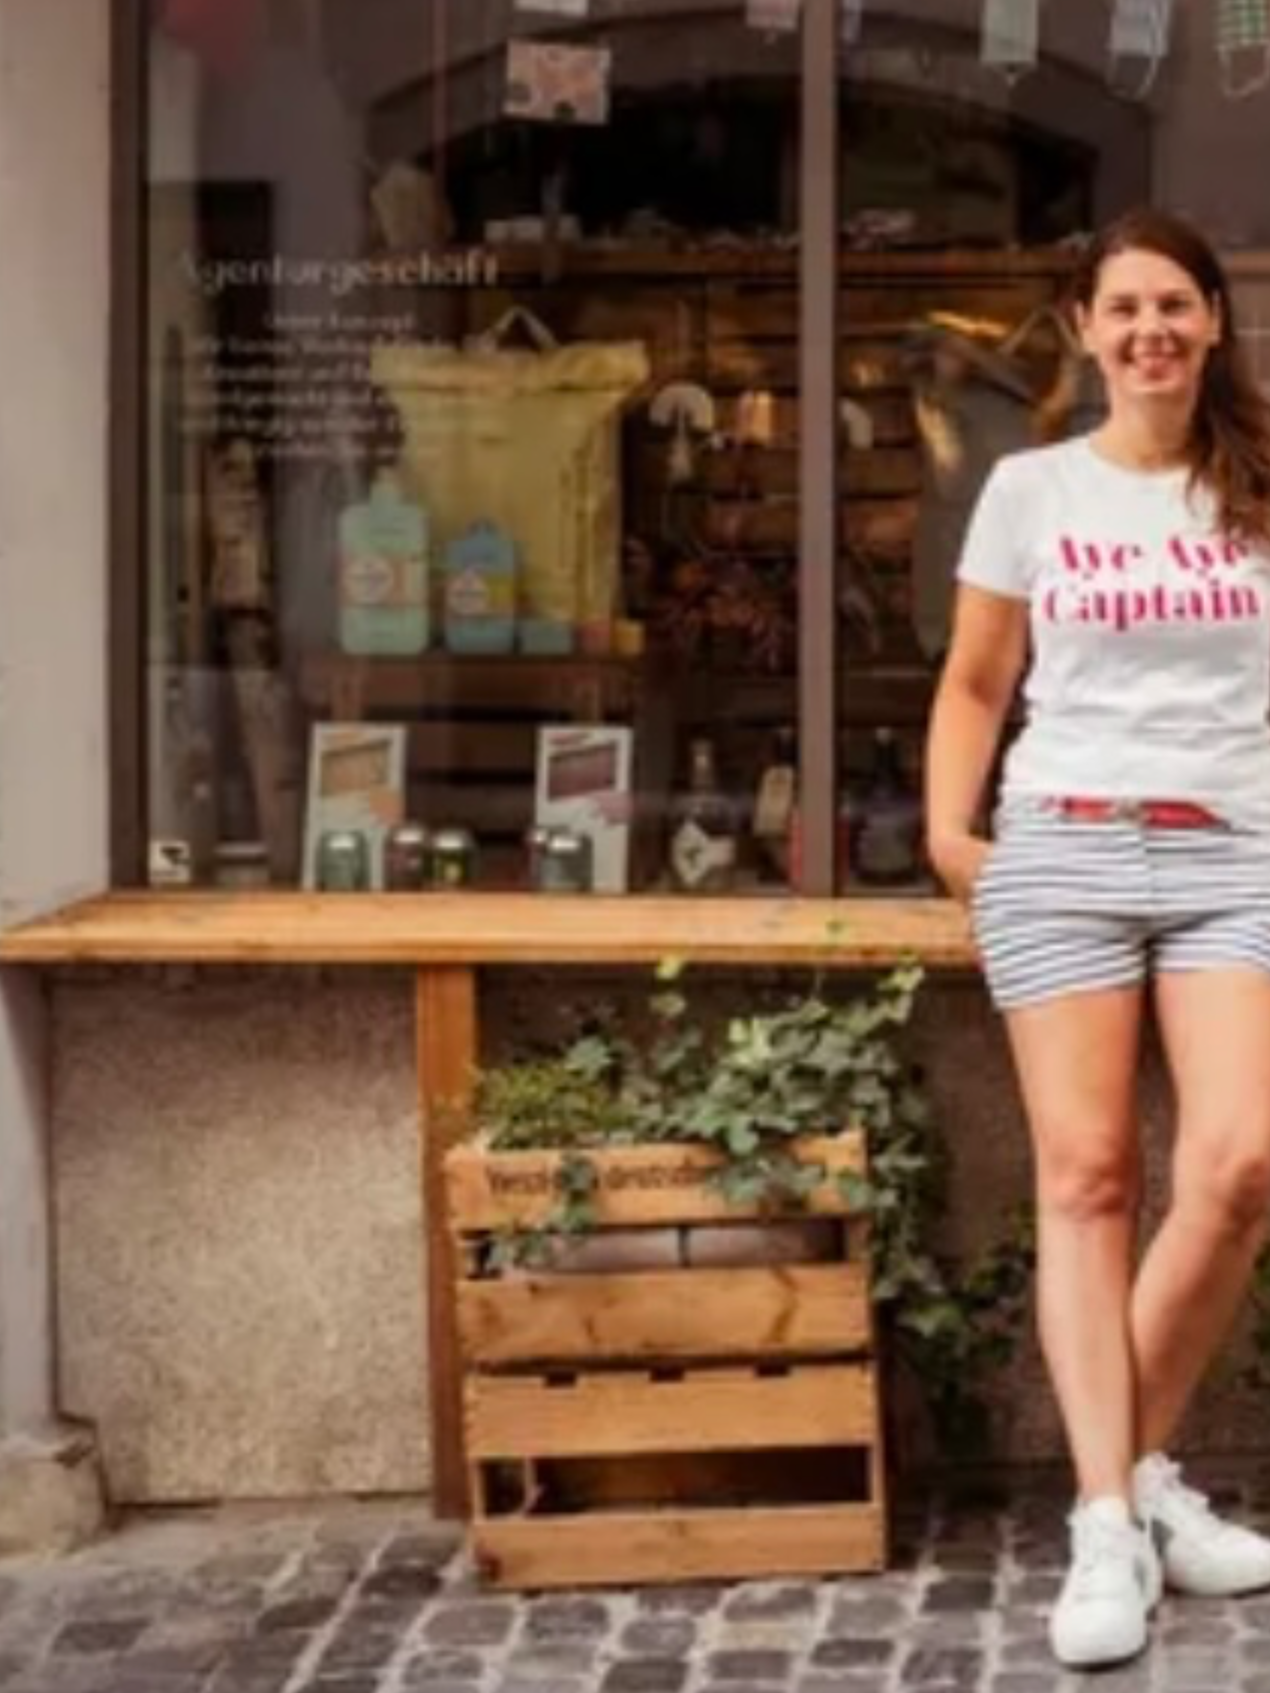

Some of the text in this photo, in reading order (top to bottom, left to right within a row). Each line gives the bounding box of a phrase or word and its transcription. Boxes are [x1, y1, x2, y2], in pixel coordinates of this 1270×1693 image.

[181, 248, 498, 294] Agenturgeschäft
[1057, 535, 1143, 578] Aye
[1044, 579, 1259, 631] Captain
